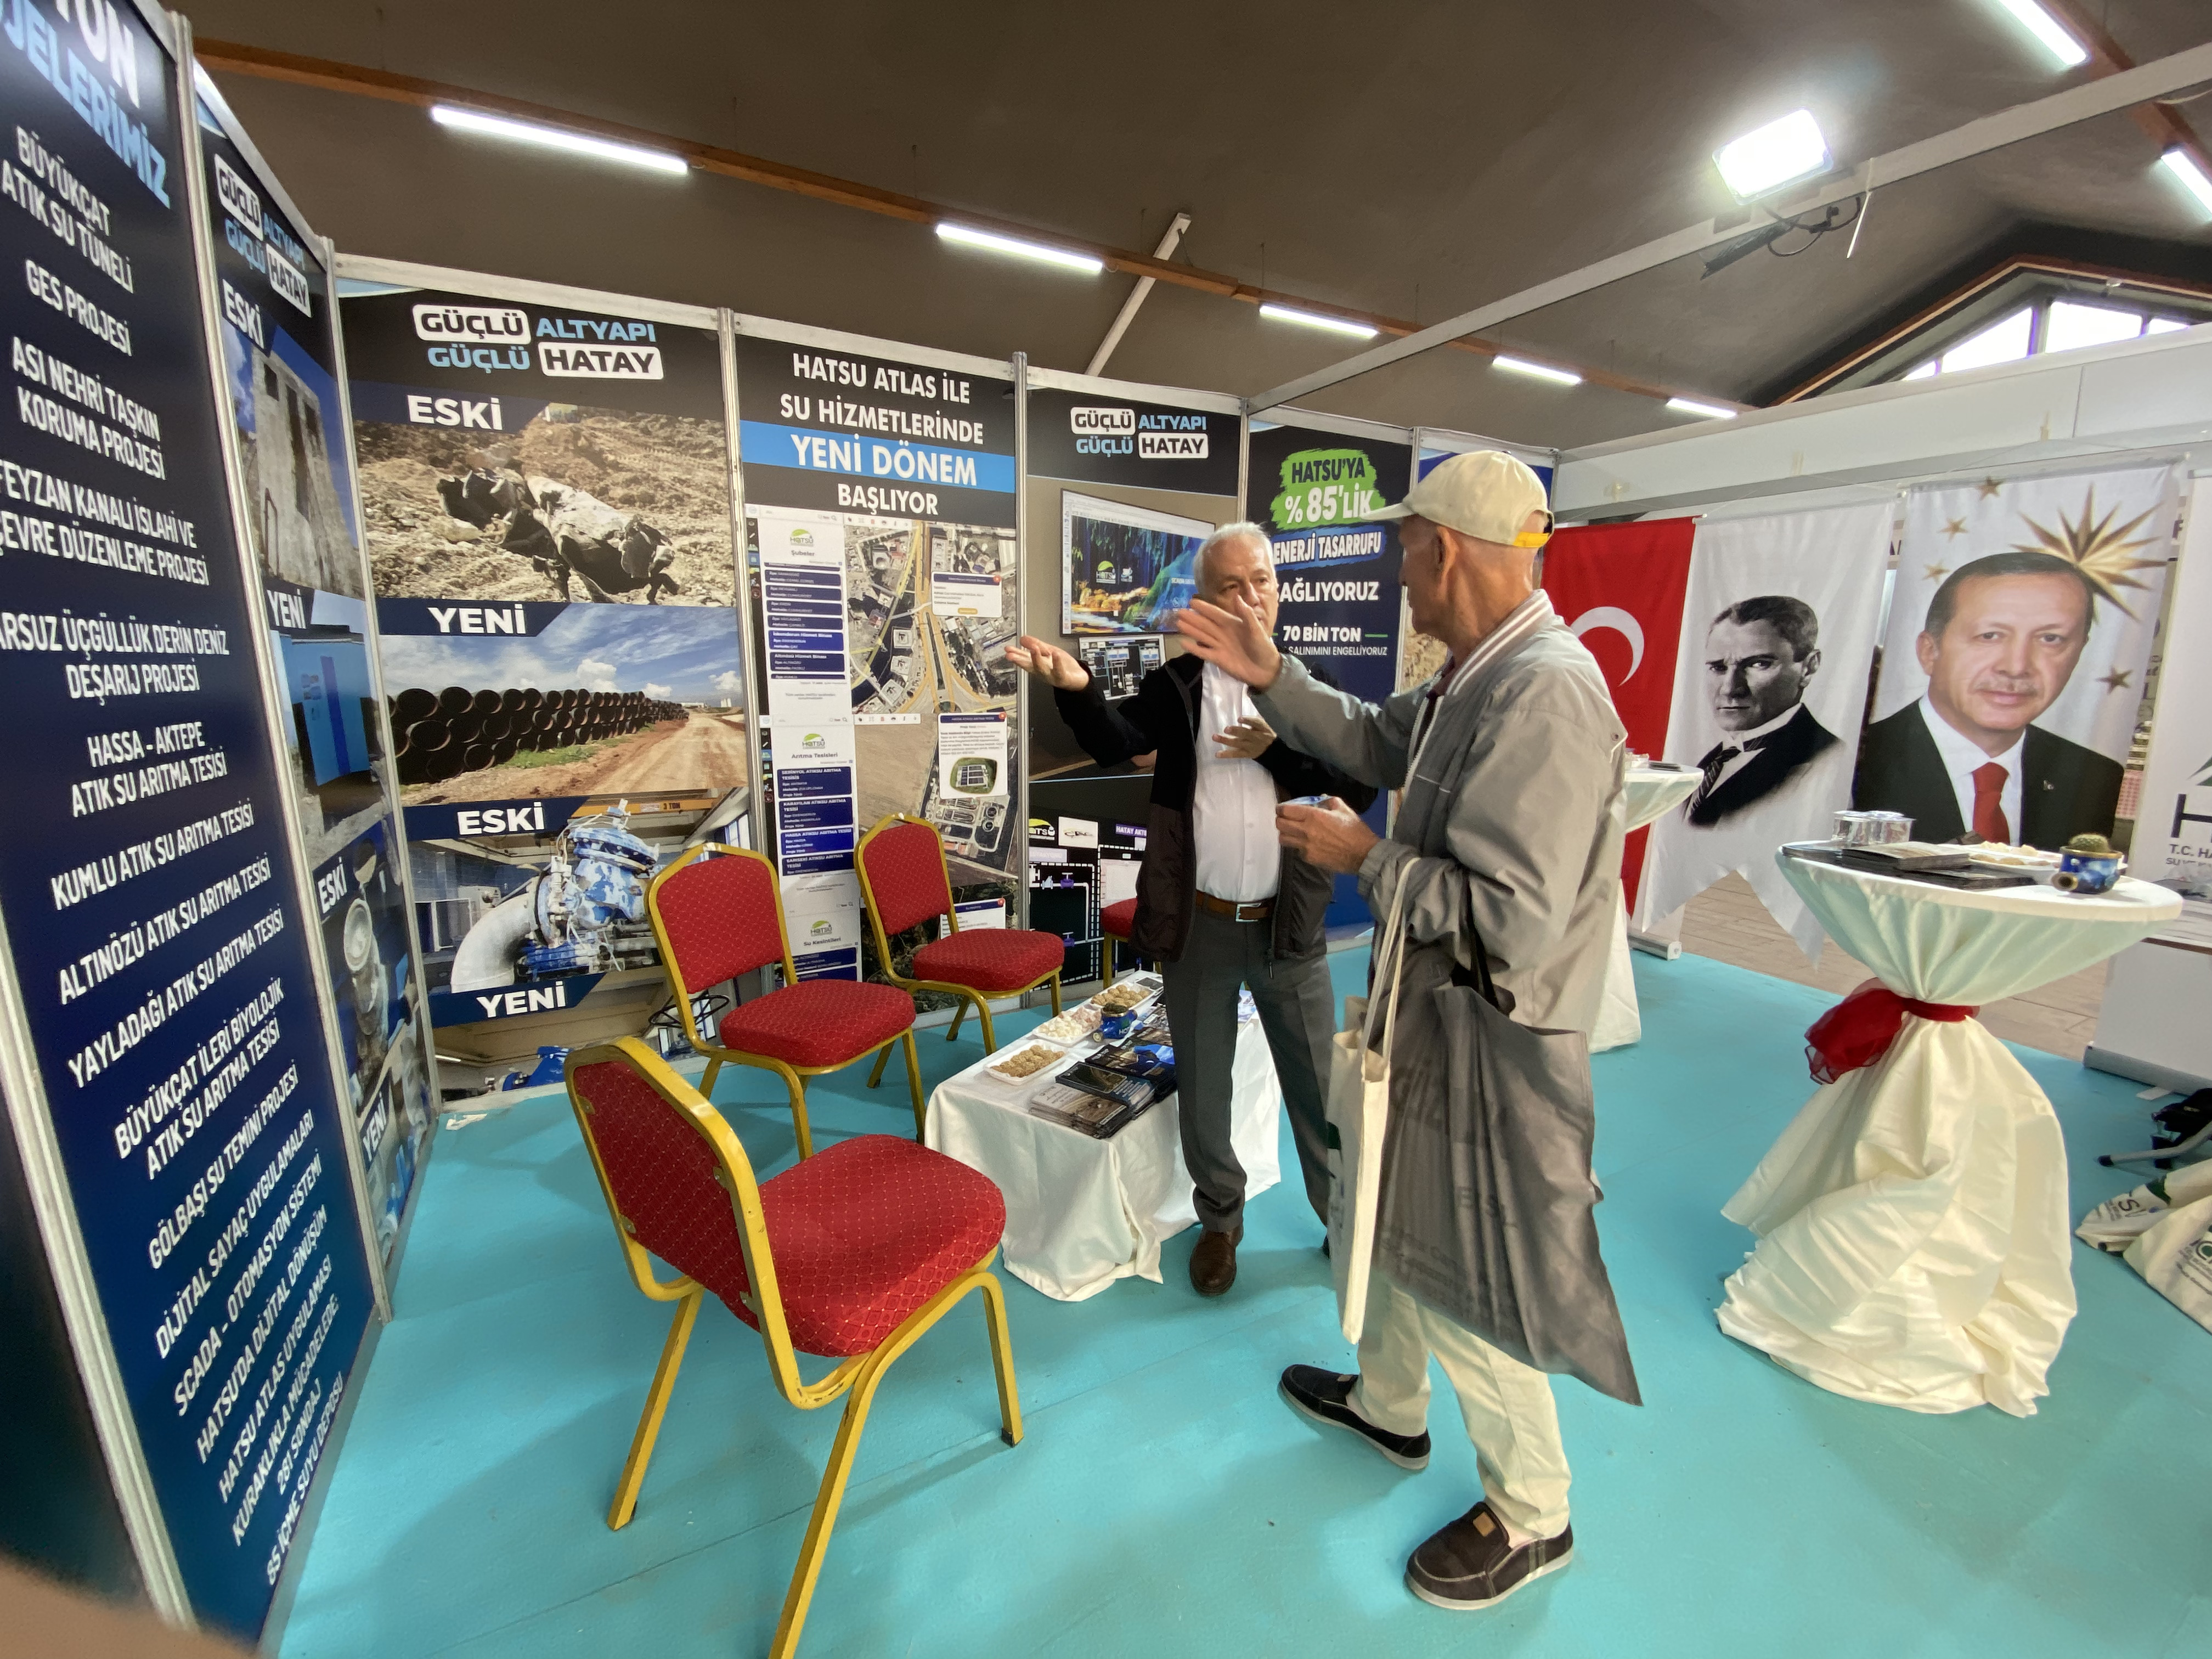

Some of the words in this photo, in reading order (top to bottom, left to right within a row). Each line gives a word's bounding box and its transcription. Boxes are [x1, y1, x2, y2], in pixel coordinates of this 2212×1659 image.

[57, 0, 140, 109] ON
[0, 0, 171, 209] JELERİMİZ
[16, 125, 111, 236] BÜYÜKÇAT
[1, 160, 50, 227] ATIK
[50, 201, 76, 246] SU
[77, 222, 134, 294] TÜNELİ
[25, 259, 64, 312] GES
[66, 286, 132, 357] PROJESİ
[223, 279, 264, 349] ESKİ
[421, 309, 523, 340] GÜÇLÜ
[537, 318, 656, 342] ALTYAPI
[12, 336, 46, 385] ASI
[48, 355, 105, 414] NEHRİ
[105, 387, 161, 441] TAŞKIN
[428, 344, 529, 374] GÜÇLÜ
[544, 349, 654, 373] HATAY
[792, 353, 867, 387] HATSU
[874, 367, 936, 399] ATLAS
[942, 371, 970, 404] İLE
[17, 386, 101, 454] KORUMA
[102, 427, 166, 480] PROJESİ
[407, 394, 503, 431] ESKİ
[780, 393, 810, 420] SU
[819, 394, 984, 444] HİZMETLERİNDE
[1074, 410, 1132, 432] GÜÇLÜ
[1138, 415, 1206, 430] ALTYAPI
[790, 433, 862, 473] YENİ
[872, 439, 978, 487] DÖNEM
[1076, 436, 1133, 457] GÜÇLÜ
[1142, 438, 1204, 454] HATAY
[1291, 458, 1365, 484] HATSU'YA
[0, 460, 72, 514] EYZAN
[75, 484, 133, 531] KANALI
[178, 520, 197, 549] VE
[837, 483, 939, 516] BAŞLIYOR
[1285, 495, 1303, 524] %
[59, 520, 157, 577] DÜZENLEME
[157, 554, 209, 585] PROJESİ
[1273, 532, 1315, 565] ENERJİ
[1318, 532, 1381, 560] TASARRUFU
[267, 589, 306, 629] YENİ
[428, 603, 527, 634] YENİ
[1279, 577, 1379, 603] AĞLIYORUZ
[61, 608, 153, 661] ÜÇGÜLLÜK
[153, 620, 193, 654] DERİN
[194, 623, 229, 656] DENİZ
[1283, 625, 1301, 641] 70
[1302, 622, 1328, 642] BİN
[1330, 627, 1361, 642] TON
[1333, 645, 1388, 656] ENGELLİYORUZ
[66, 663, 140, 706] DEŞARIJ
[142, 658, 200, 694] PROJESİ
[87, 730, 145, 768] HASSA
[155, 721, 206, 755] AKTEPE
[71, 780, 115, 817] ATIK
[115, 774, 137, 805] SU
[140, 758, 191, 799] ARITMA
[189, 746, 228, 783] TESİSİ
[457, 802, 545, 836] ESKİ
[51, 855, 117, 910] KUMLU
[119, 841, 156, 881] ATIK
[155, 834, 176, 865] SU
[177, 815, 223, 857] ARITMA
[221, 798, 255, 836] TESİSİ
[2169, 844, 2194, 856] T.C.
[318, 857, 347, 913] ESKİ
[58, 921, 145, 1005] ALTINÖZÜ
[146, 910, 180, 951] ATIK
[179, 897, 199, 930] SU
[200, 874, 242, 919] ARITMA
[240, 851, 272, 892] TESİSİ
[68, 990, 166, 1088] YAYLADAĞI
[167, 975, 198, 1017] ATIK
[197, 958, 215, 991] SU
[216, 929, 255, 978] ARITMA
[253, 903, 284, 947] TESİSİ
[476, 981, 567, 1018] YENİ
[114, 1056, 198, 1159] BÜYÜKÇAT
[197, 1019, 231, 1077] İLERİ
[231, 977, 284, 1046] BİYOLOJİK
[147, 1122, 184, 1180] ATIK
[183, 1102, 203, 1139] SU
[204, 1051, 250, 1118] ARITMA
[246, 1012, 281, 1066] TESİSİ
[362, 1092, 386, 1161] YENİ
[148, 1177, 209, 1269] GÖLBAŞI
[207, 1155, 225, 1195] SU
[223, 1103, 261, 1171] TEMİNİ
[261, 1058, 299, 1127] PROJESİ
[155, 1266, 211, 1359] DİJİTAL
[208, 1206, 249, 1278] SAYAÇ
[247, 1109, 314, 1220] UYGULAMALARI
[173, 1325, 222, 1417] SCADA
[227, 1203, 291, 1323] OTOMASYON
[288, 1148, 322, 1218] SİSTEMİ
[252, 1278, 290, 1355] DİJİTAL
[287, 1204, 328, 1287] DÖNÜŞÜM
[219, 1413, 256, 1503] HATSU
[255, 1351, 285, 1426] ATLAS
[283, 1254, 332, 1362] UYGULAMASI
[291, 1378, 321, 1459] SONDAJ
[233, 1404, 291, 1547] KURAKLIKLA
